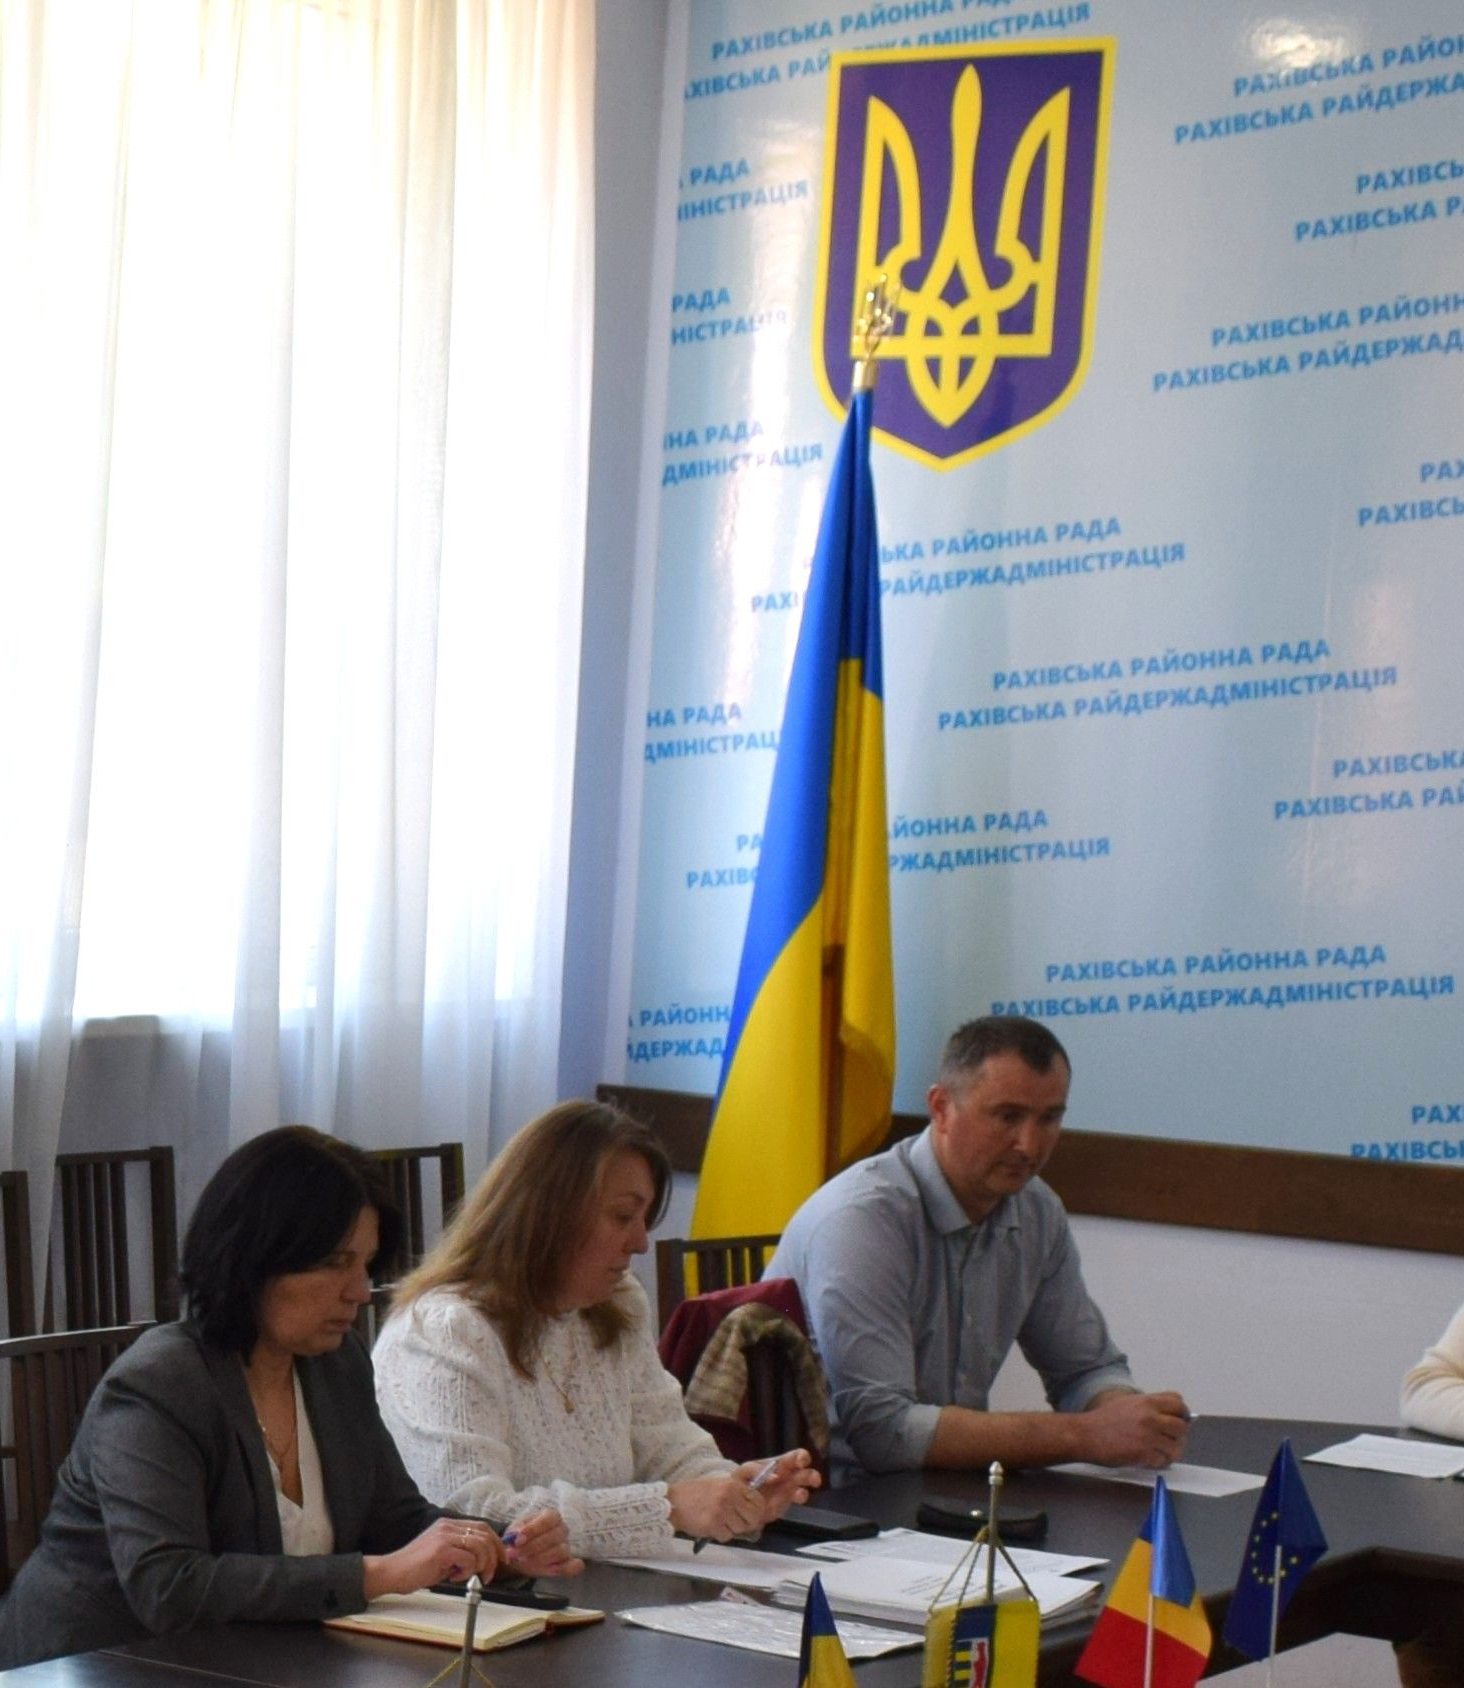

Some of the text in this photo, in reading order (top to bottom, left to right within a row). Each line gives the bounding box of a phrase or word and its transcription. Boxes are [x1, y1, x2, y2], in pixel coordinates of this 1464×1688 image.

[709, 21, 832, 62] РАХІВСЬКА
[1234, 55, 1374, 96] РАХІВСЬКА
[1174, 102, 1314, 143] РАХІВСЬКА
[689, 158, 750, 186] РАДА
[1294, 200, 1438, 241] РАХІВСЬКА
[671, 287, 732, 314] РАДА
[1211, 310, 1351, 346] РАХІВСЬКА
[1153, 355, 1292, 390] РАХІВСЬКА
[706, 420, 765, 446] РАДА
[933, 527, 1048, 554] РАЙОННА
[1056, 518, 1121, 541] РАДА
[993, 640, 1329, 690] РАХІВСЬКА РАЙОННА РАДА
[683, 702, 742, 726] РАДА
[937, 669, 1396, 730] РАХІВСЬКА РАЙДЕРЖАДМІНІСТРАЦІЯ
[1274, 792, 1413, 819] РАХІВСЬКА
[890, 808, 1049, 840] ЙОННА РАДА
[1045, 945, 1387, 982] РАХІВСЬКА РАЙОННА РАДА
[991, 975, 1457, 1018] РАХІВСЬКА РАЙДЕРЖАДМІНІСТРАЦІЯ
